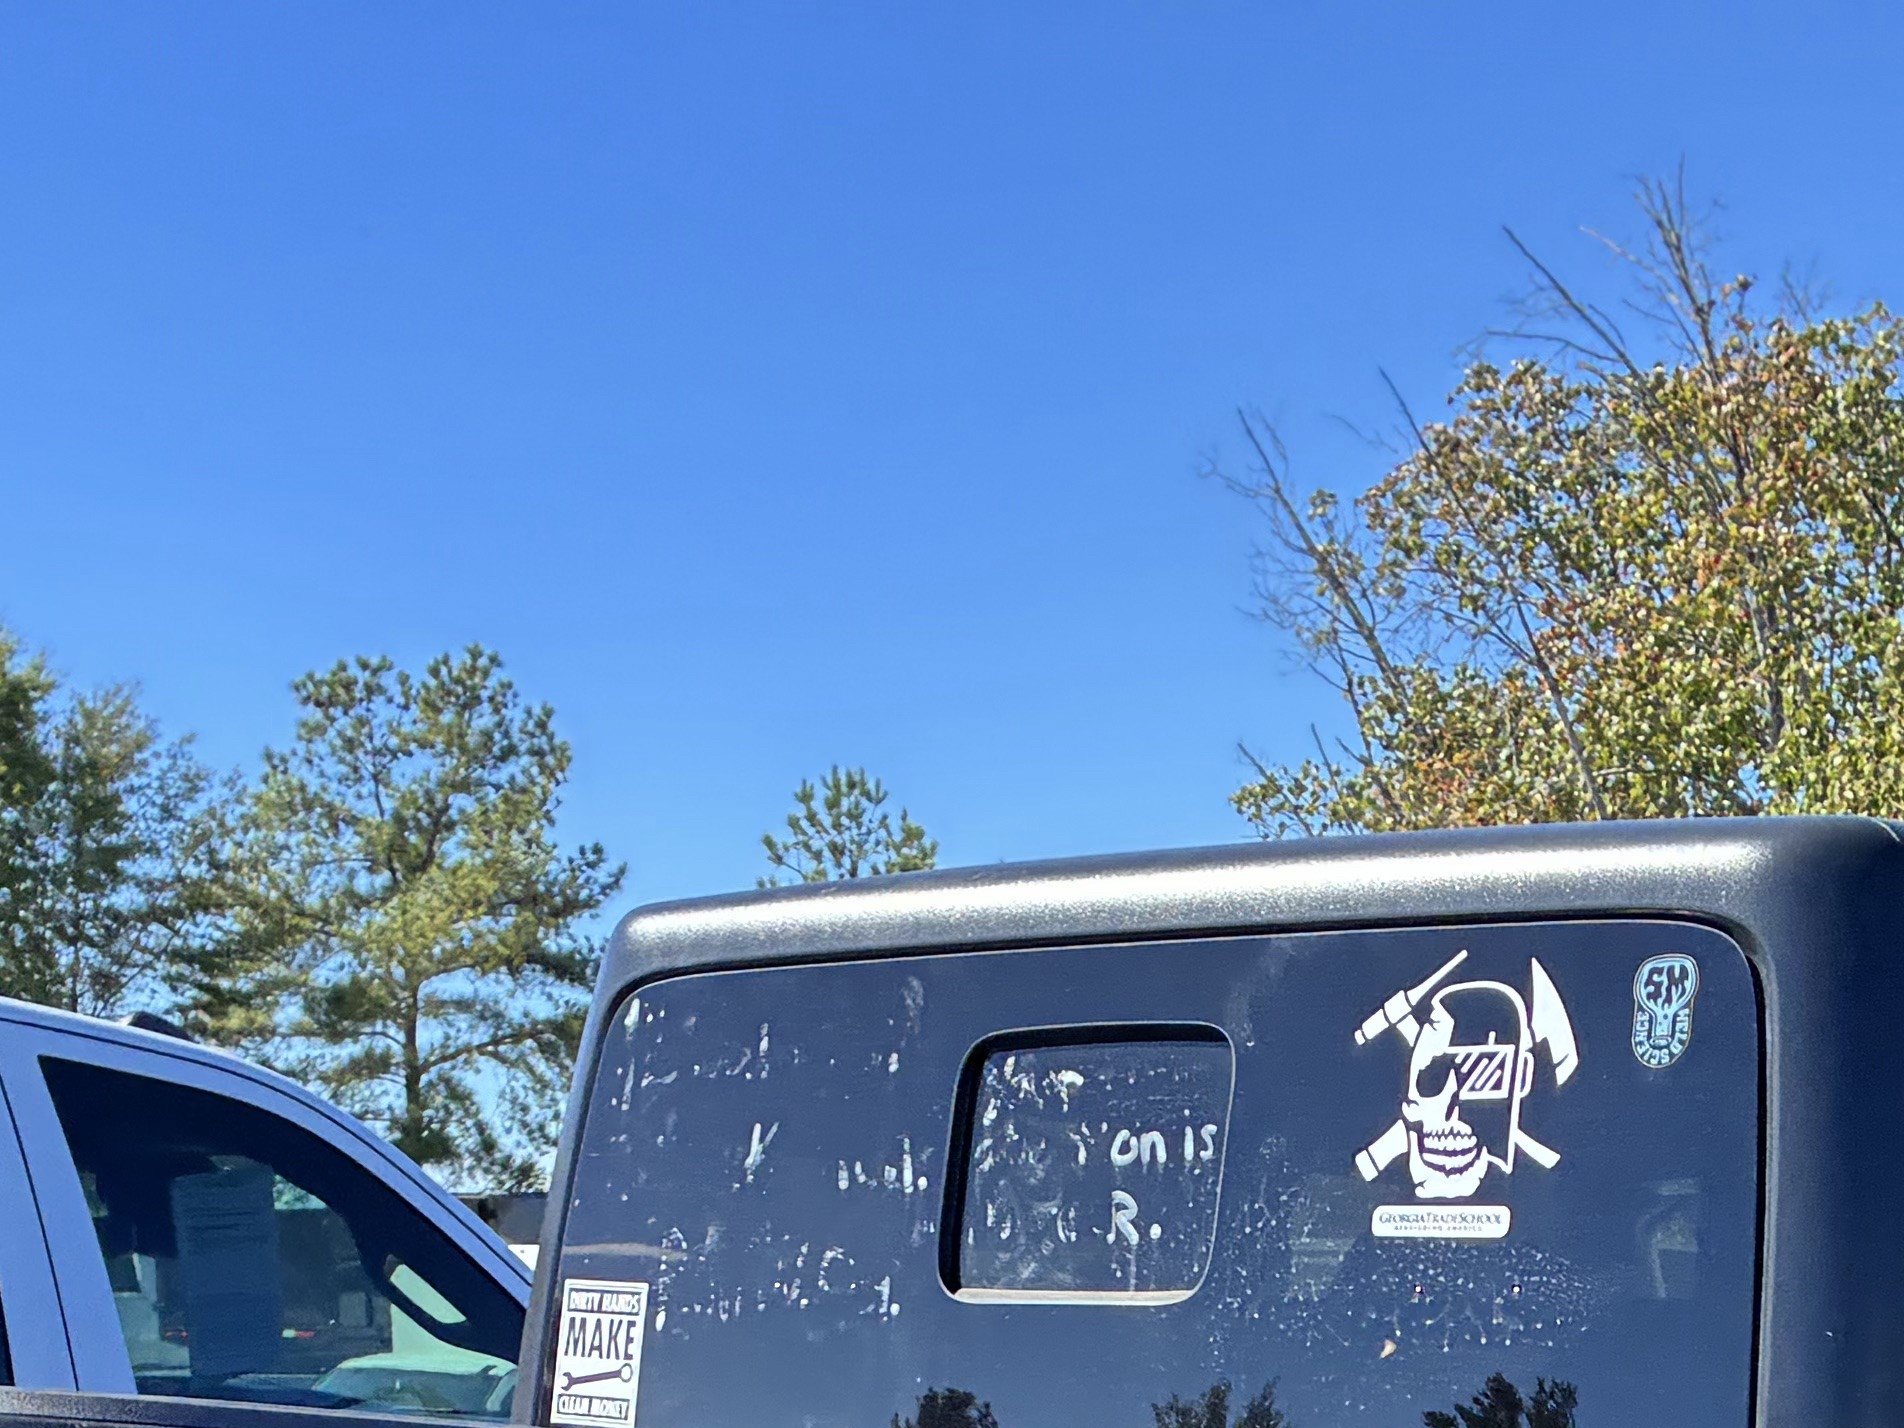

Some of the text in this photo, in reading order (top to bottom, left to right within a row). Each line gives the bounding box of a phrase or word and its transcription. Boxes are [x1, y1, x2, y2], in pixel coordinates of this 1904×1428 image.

[569, 1291, 640, 1313] DIRTY HANDS
[564, 1317, 636, 1360] MAKE
